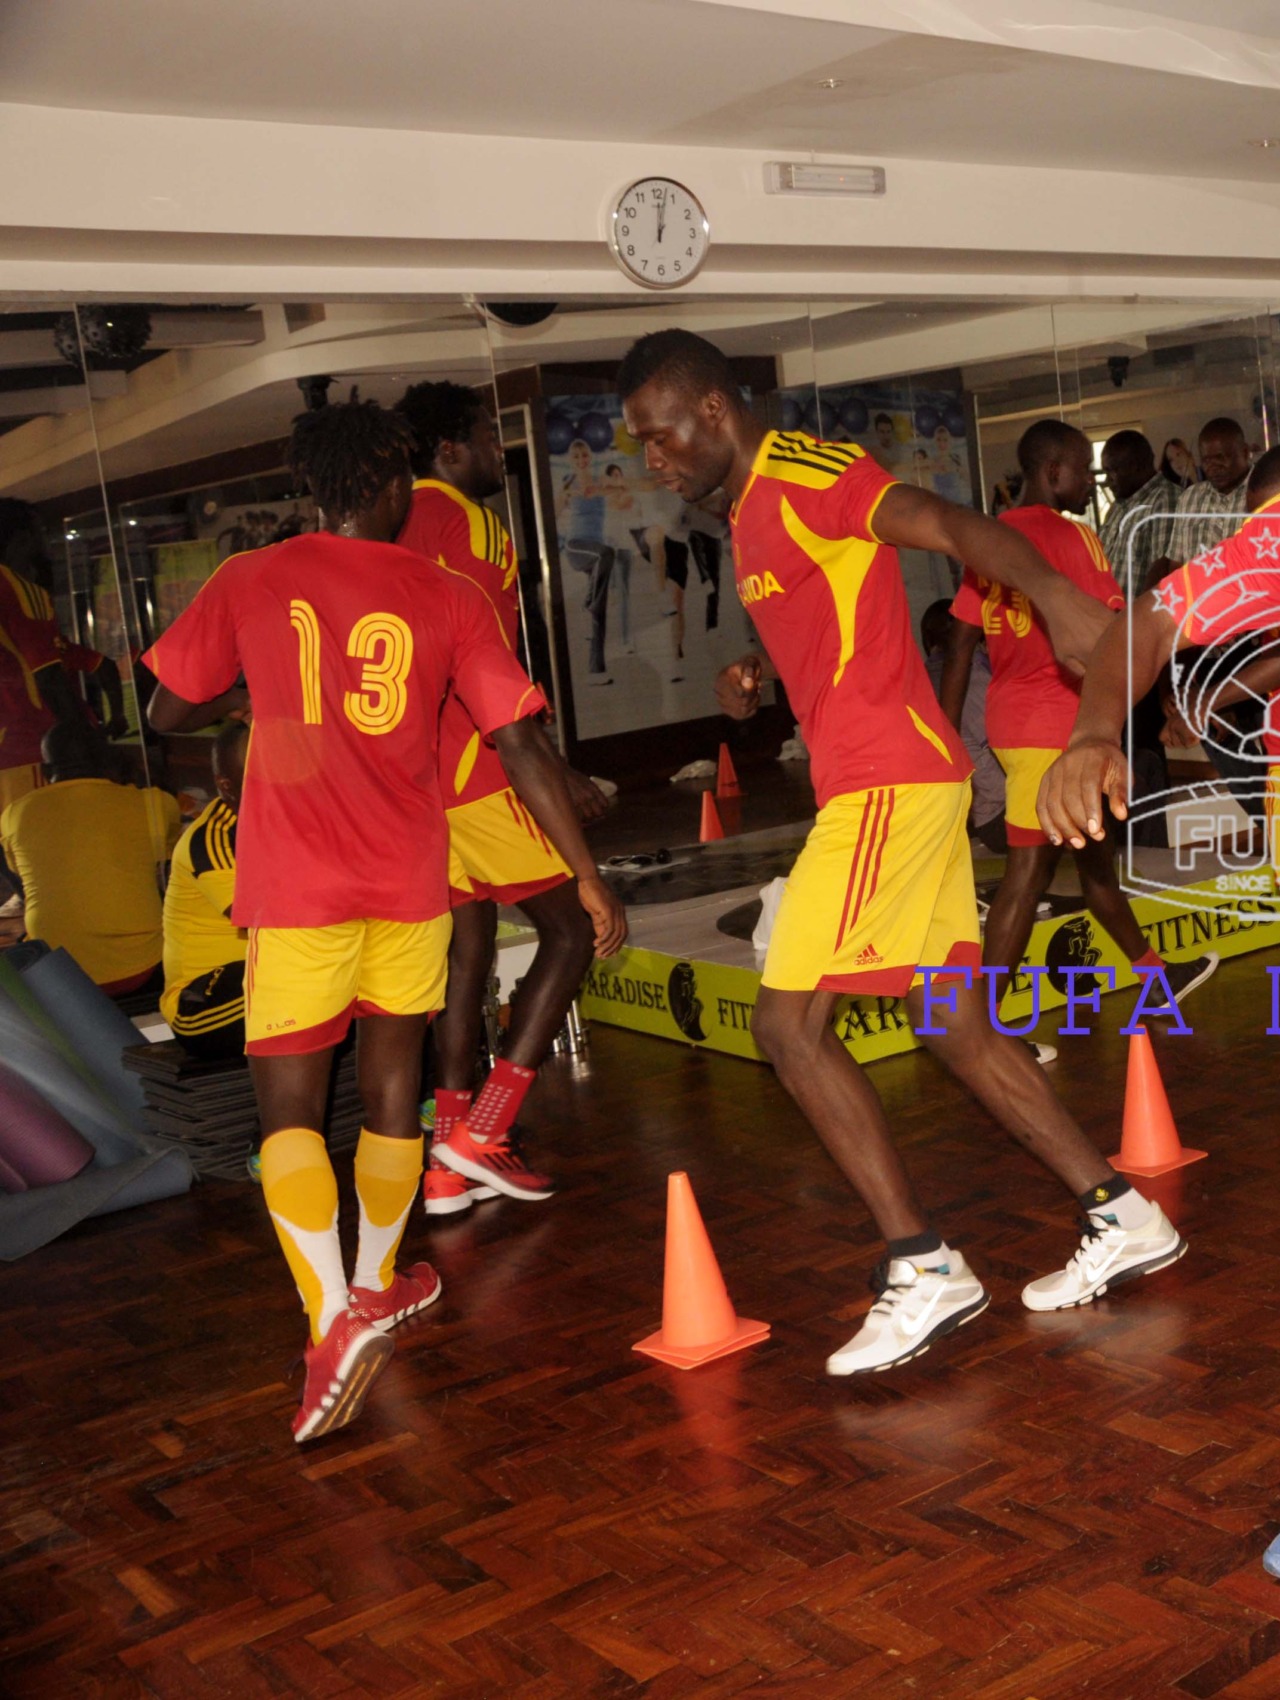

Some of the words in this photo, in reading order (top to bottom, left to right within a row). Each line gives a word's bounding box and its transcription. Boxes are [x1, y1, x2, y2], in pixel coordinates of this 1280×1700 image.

[635, 192, 645, 203] 11
[651, 187, 663, 200] 12
[624, 207, 637, 219] 10
[289, 598, 415, 736] 13
[580, 970, 668, 1013] ARADISE
